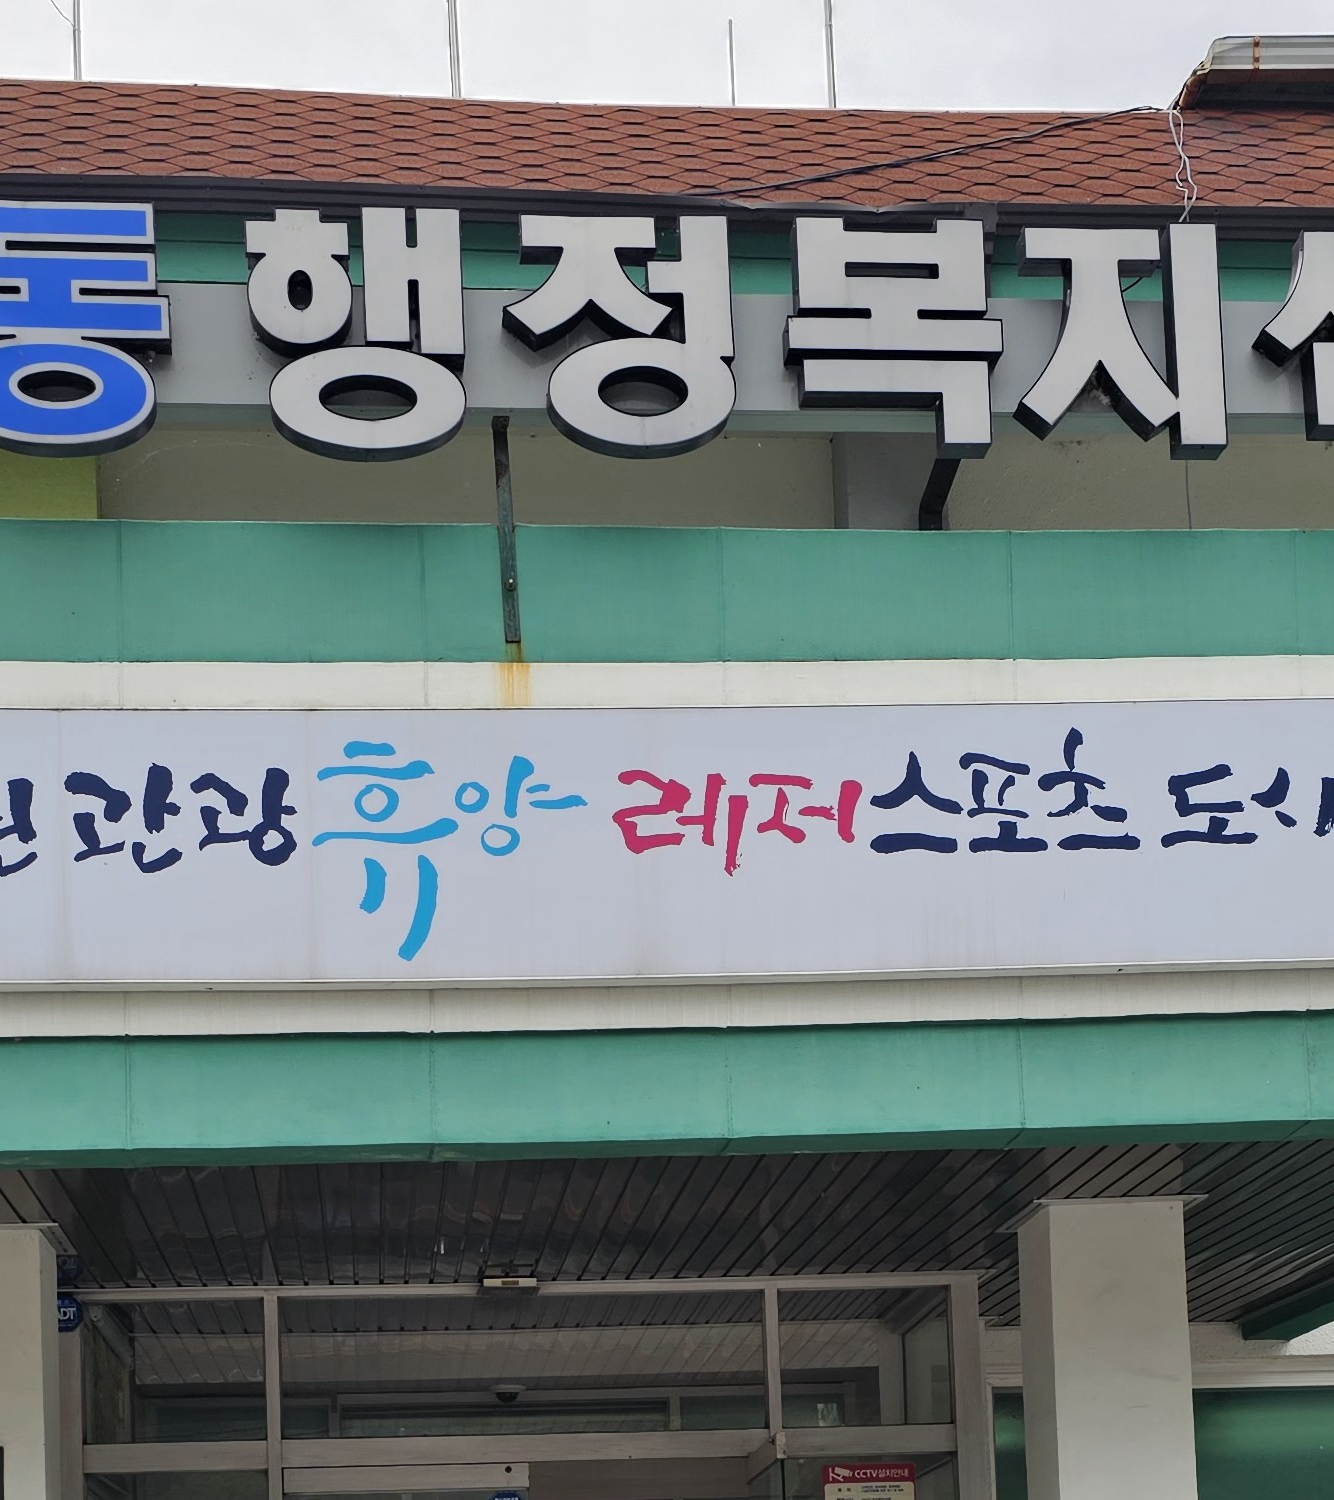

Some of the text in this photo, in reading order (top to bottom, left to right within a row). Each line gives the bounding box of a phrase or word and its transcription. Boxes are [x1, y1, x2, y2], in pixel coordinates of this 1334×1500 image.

[65, 762, 299, 874] 관광
[312, 740, 587, 962] 휴양
[612, 768, 863, 876] 레저
[869, 727, 1141, 854] 스포츠
